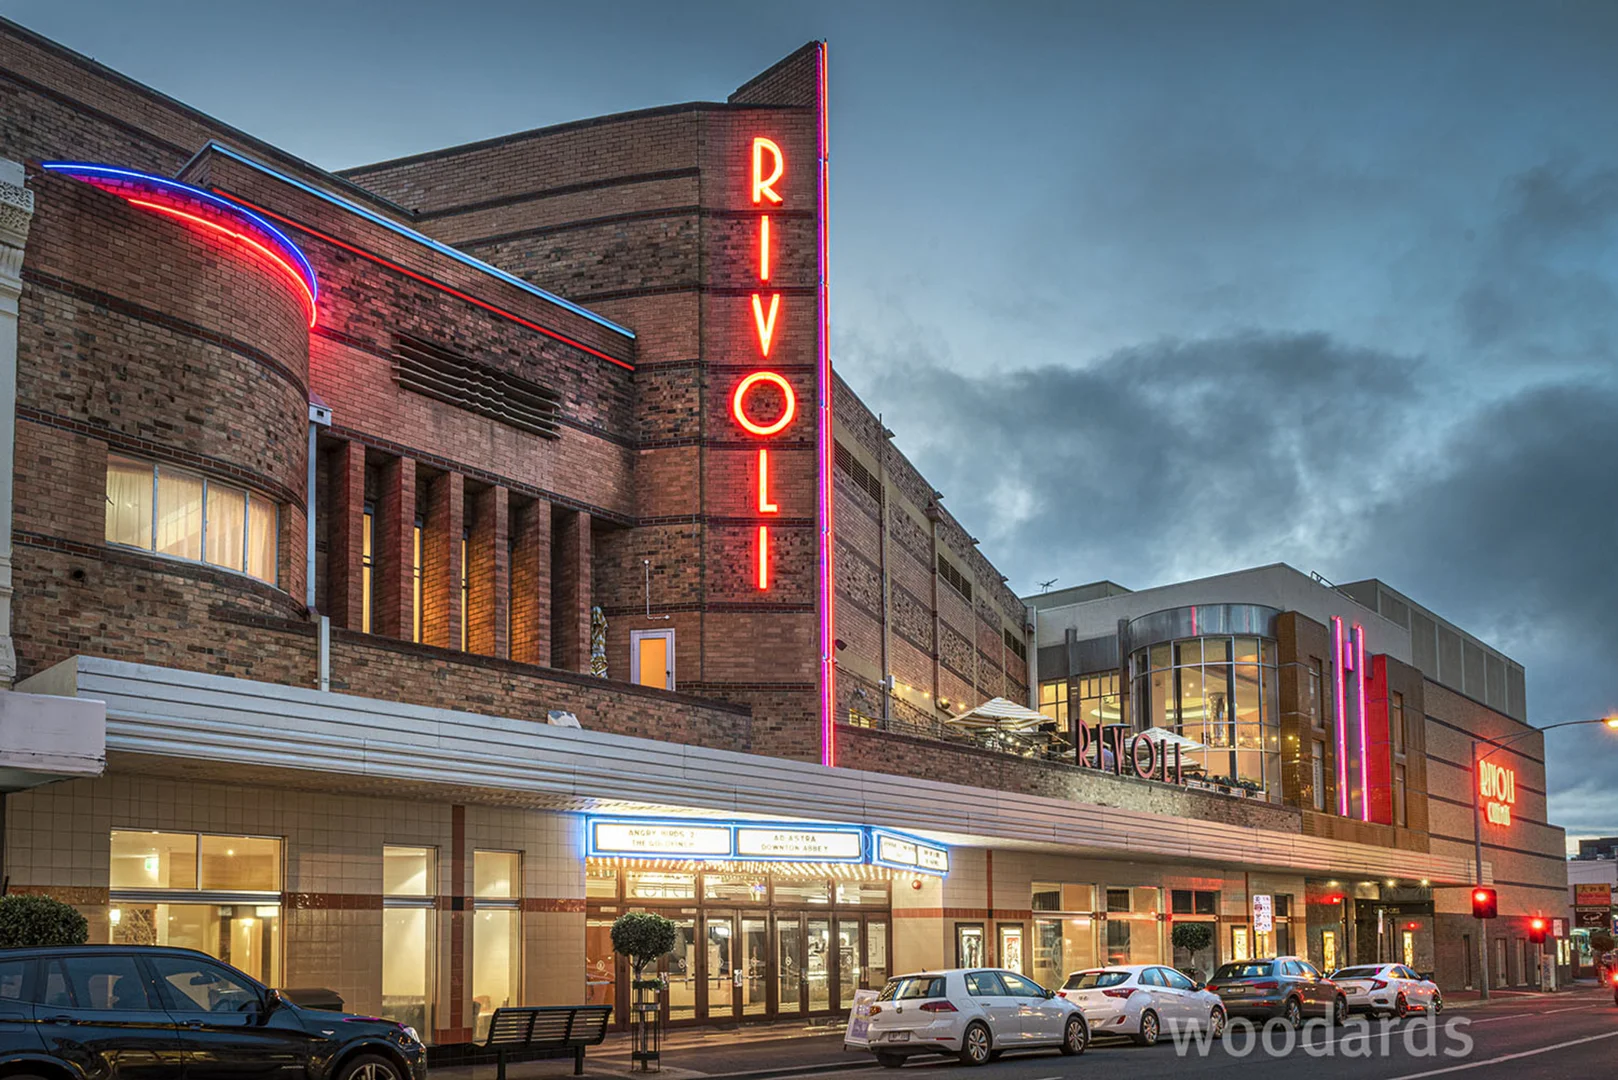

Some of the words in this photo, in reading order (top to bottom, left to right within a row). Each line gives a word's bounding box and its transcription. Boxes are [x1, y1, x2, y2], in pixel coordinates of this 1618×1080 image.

[732, 136, 796, 590] RIVOLI
[1076, 719, 1182, 785] RIVOLI
[1479, 759, 1515, 804] RIVOLI
[628, 829, 656, 837] ANGRY
[773, 834, 785, 842] AD
[788, 835, 817, 843] ASTRA
[760, 843, 800, 851] DOWNTON
[802, 845, 828, 853] ABBEY
